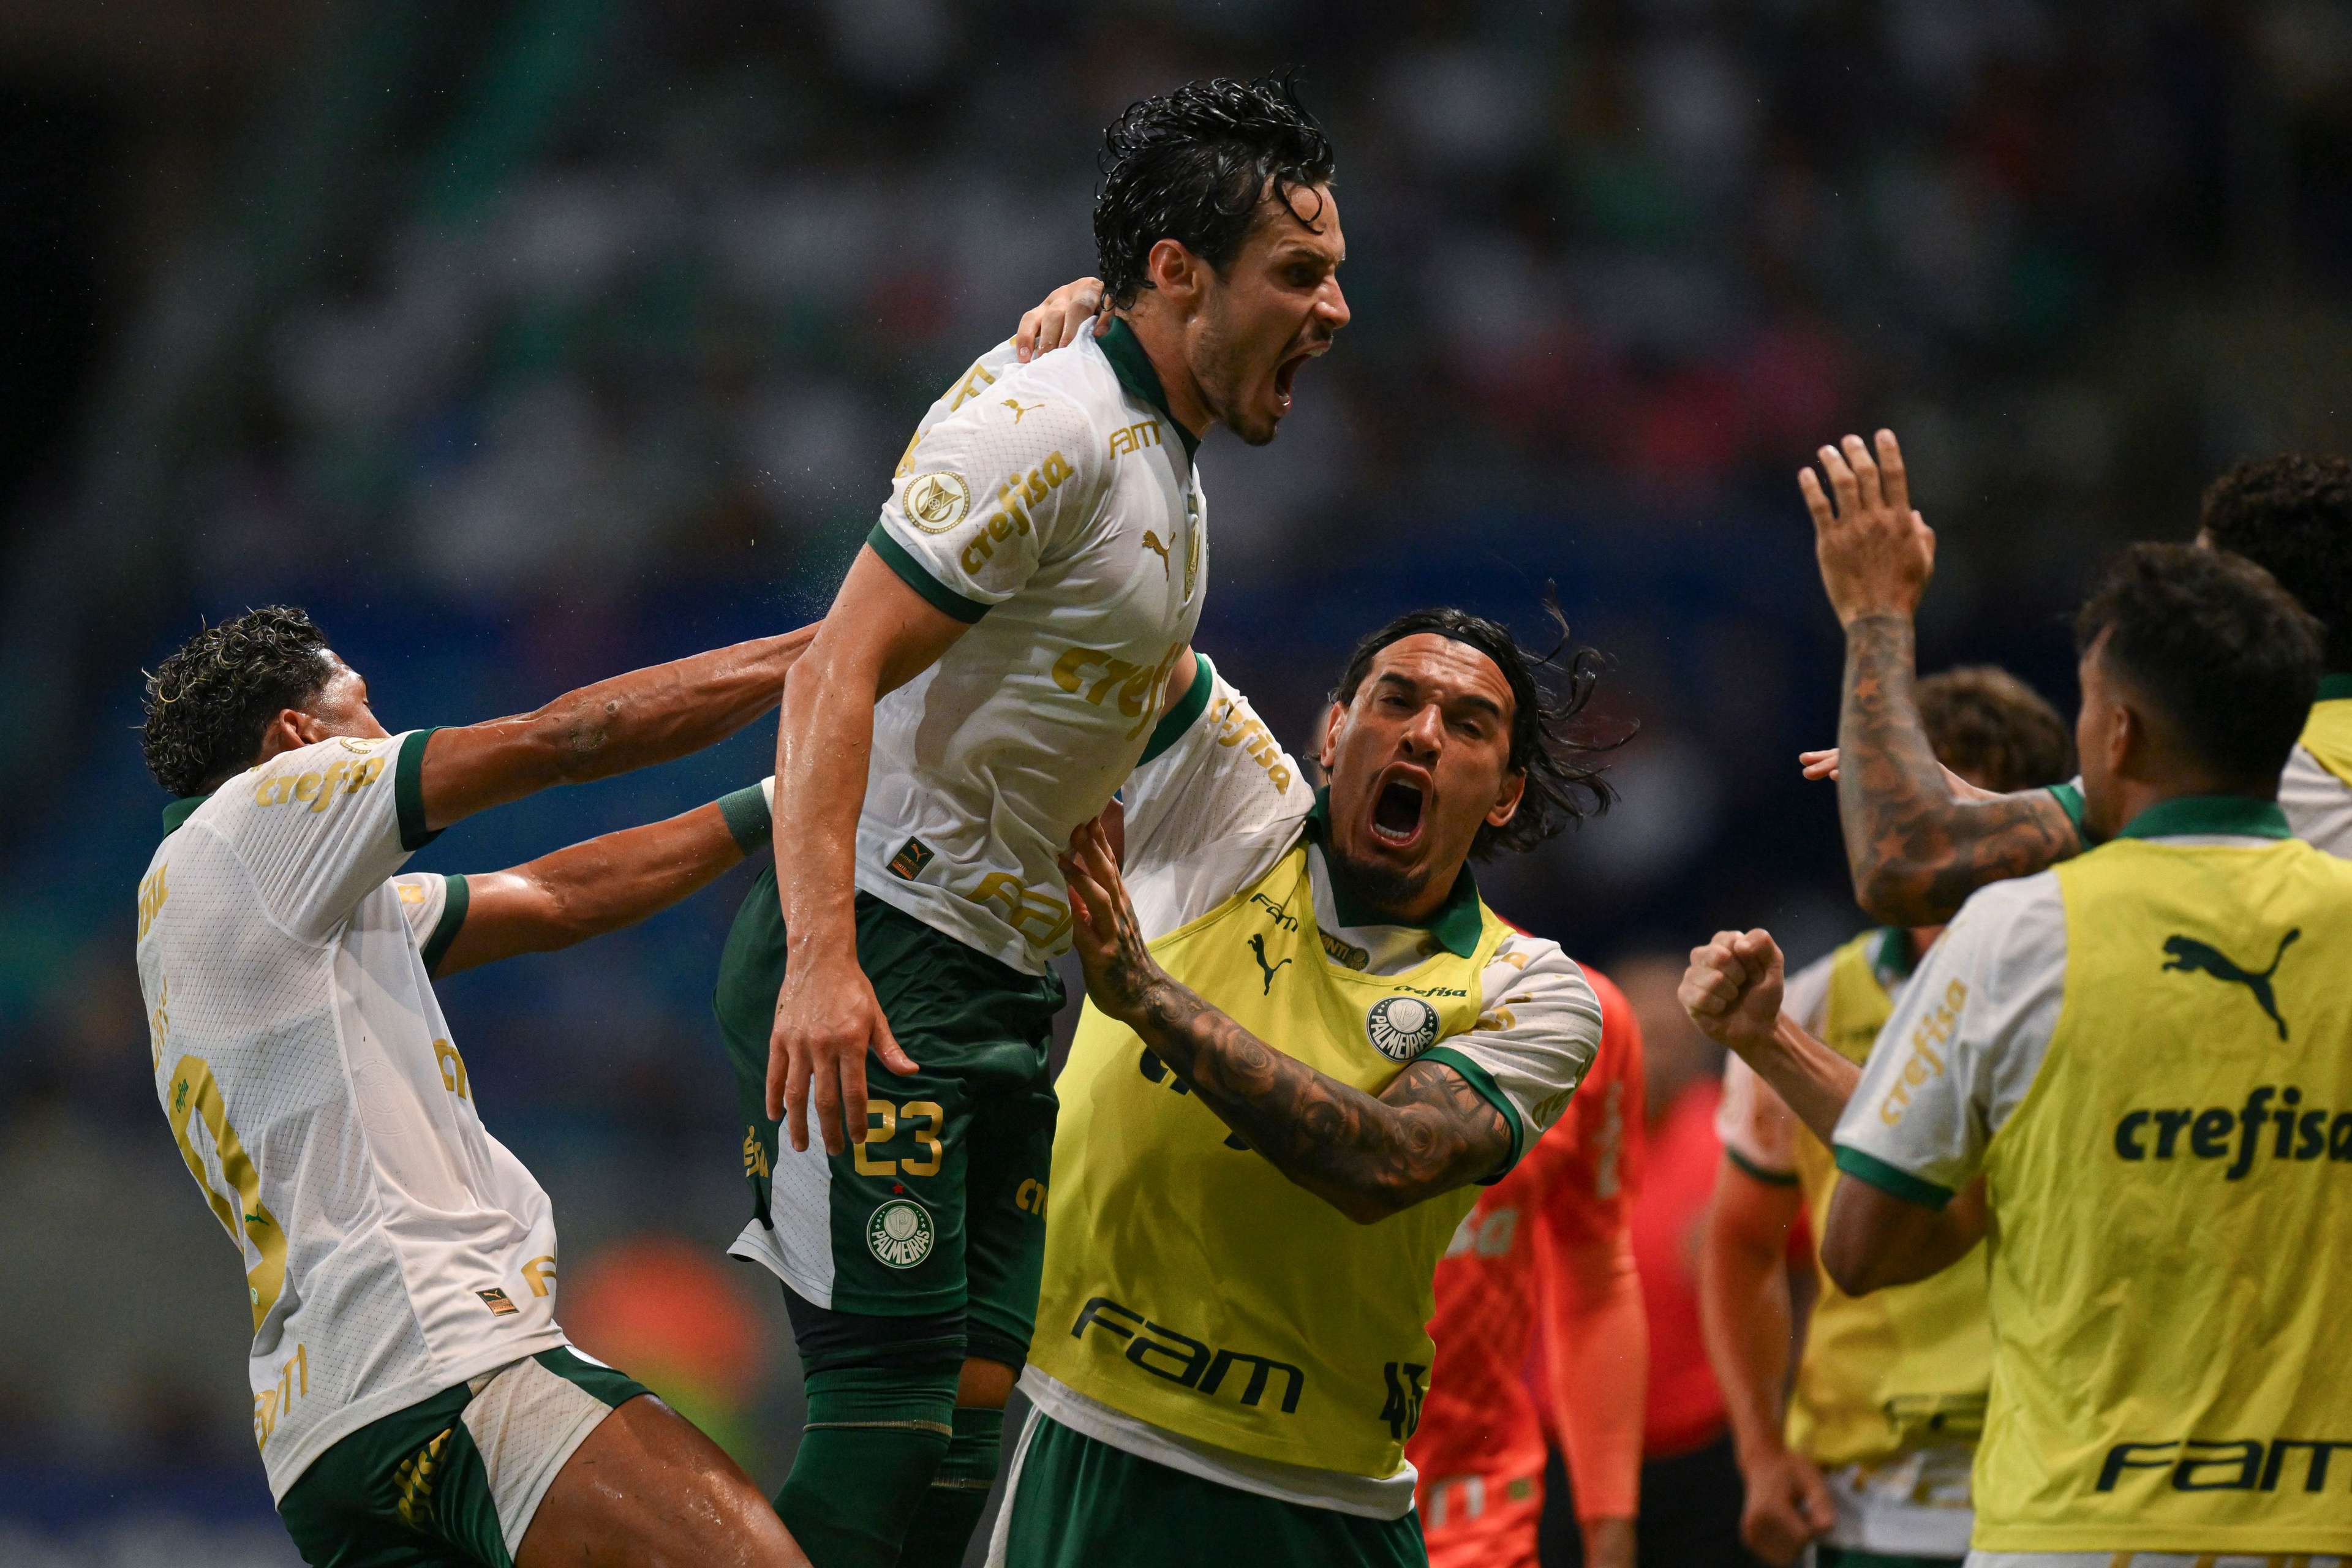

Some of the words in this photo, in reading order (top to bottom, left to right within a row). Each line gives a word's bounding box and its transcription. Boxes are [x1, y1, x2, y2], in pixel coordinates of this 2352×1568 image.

[960, 450, 1074, 575] crefisa
[1393, 986, 1467, 997] crefisa
[1370, 1015, 1434, 1059] PALMEIRAS
[1880, 978, 1967, 1126] crefisa
[853, 1099, 943, 1177] 23
[872, 1229, 930, 1264] PALMEIRAS
